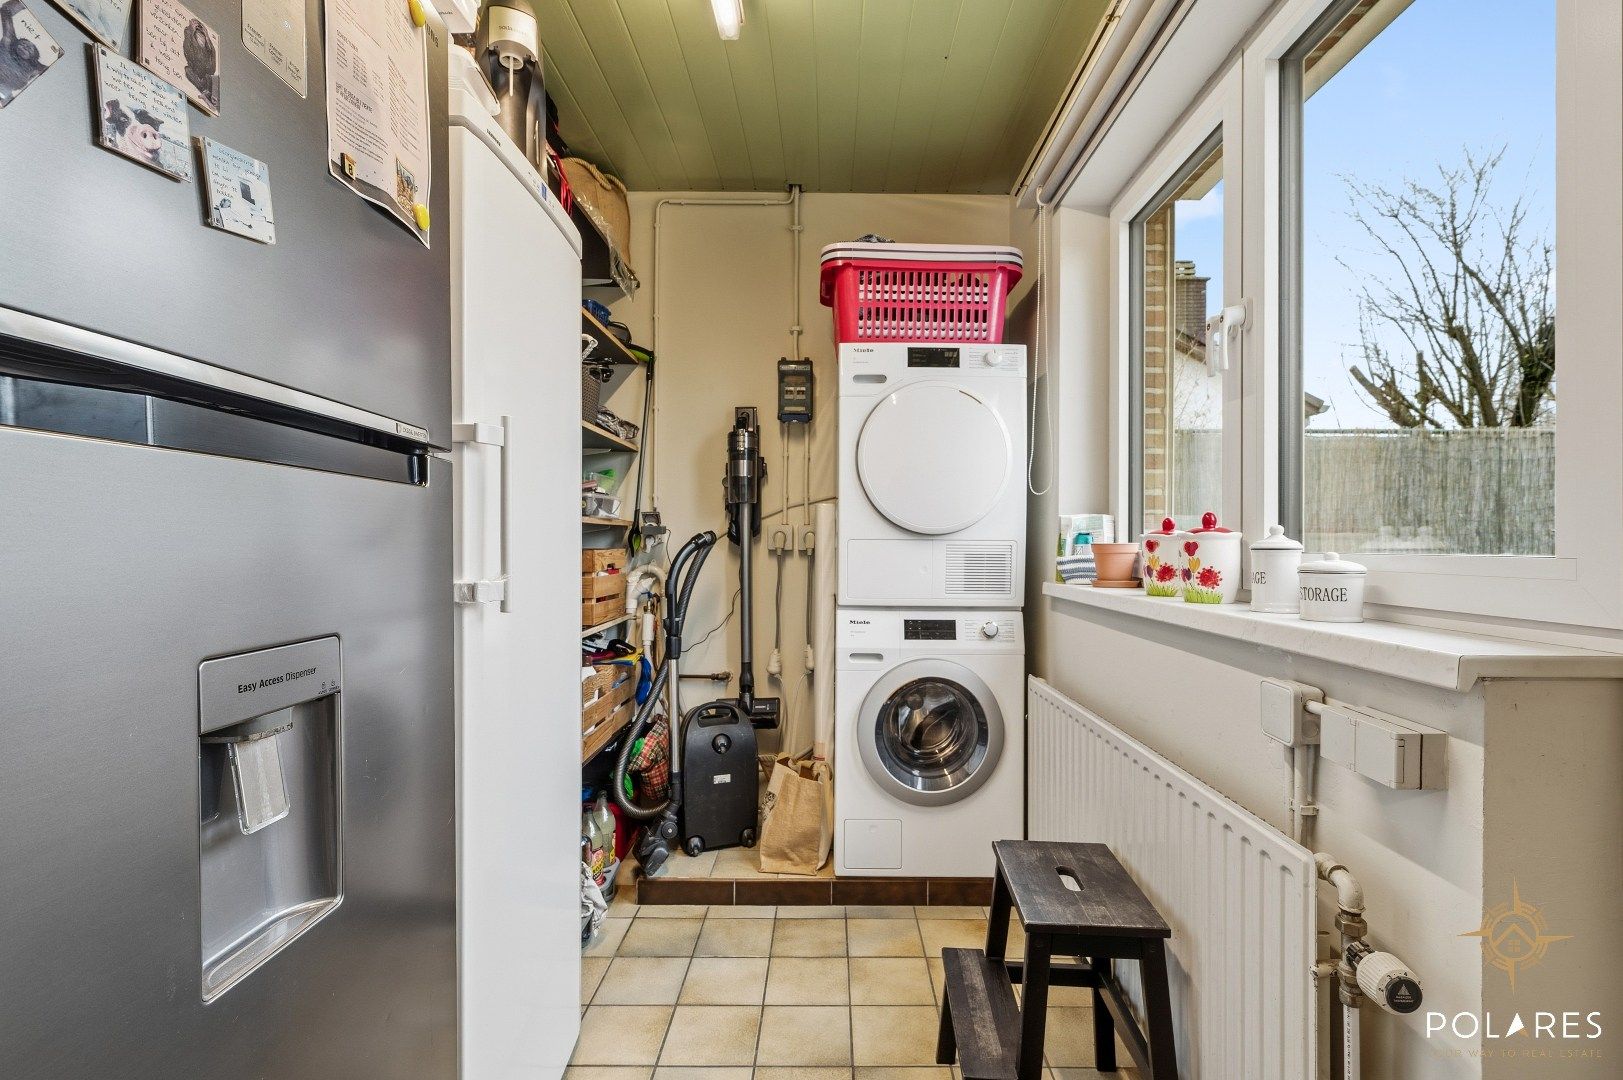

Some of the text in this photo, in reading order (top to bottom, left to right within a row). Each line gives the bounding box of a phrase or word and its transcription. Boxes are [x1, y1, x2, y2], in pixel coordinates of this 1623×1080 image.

[21, 19, 41, 40] niet
[237, 667, 317, 694] Easy Access Dispenser
